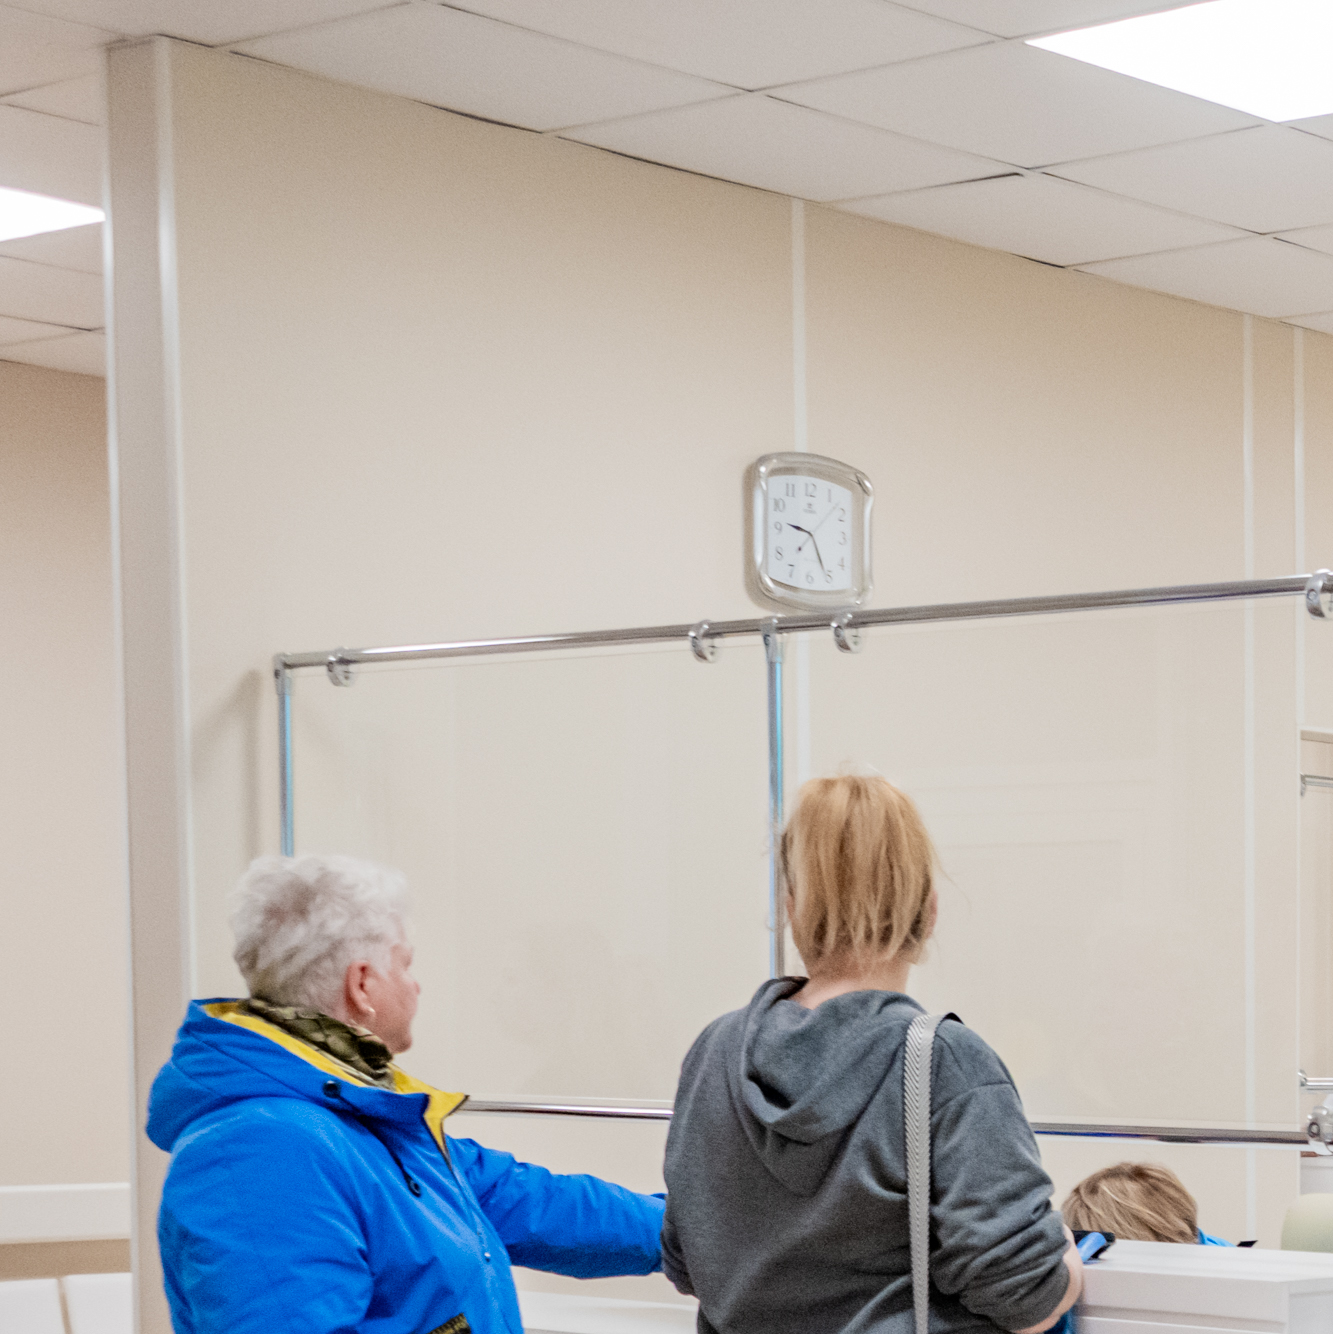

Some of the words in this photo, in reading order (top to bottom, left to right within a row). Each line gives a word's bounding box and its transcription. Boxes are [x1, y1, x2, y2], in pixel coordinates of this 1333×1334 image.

[805, 482, 817, 498] 12
[773, 498, 786, 512] 10
[838, 507, 846, 522] 2
[774, 521, 783, 535] 9
[838, 531, 847, 545] 3
[775, 546, 783, 561] 8
[806, 571, 814, 584] 6
